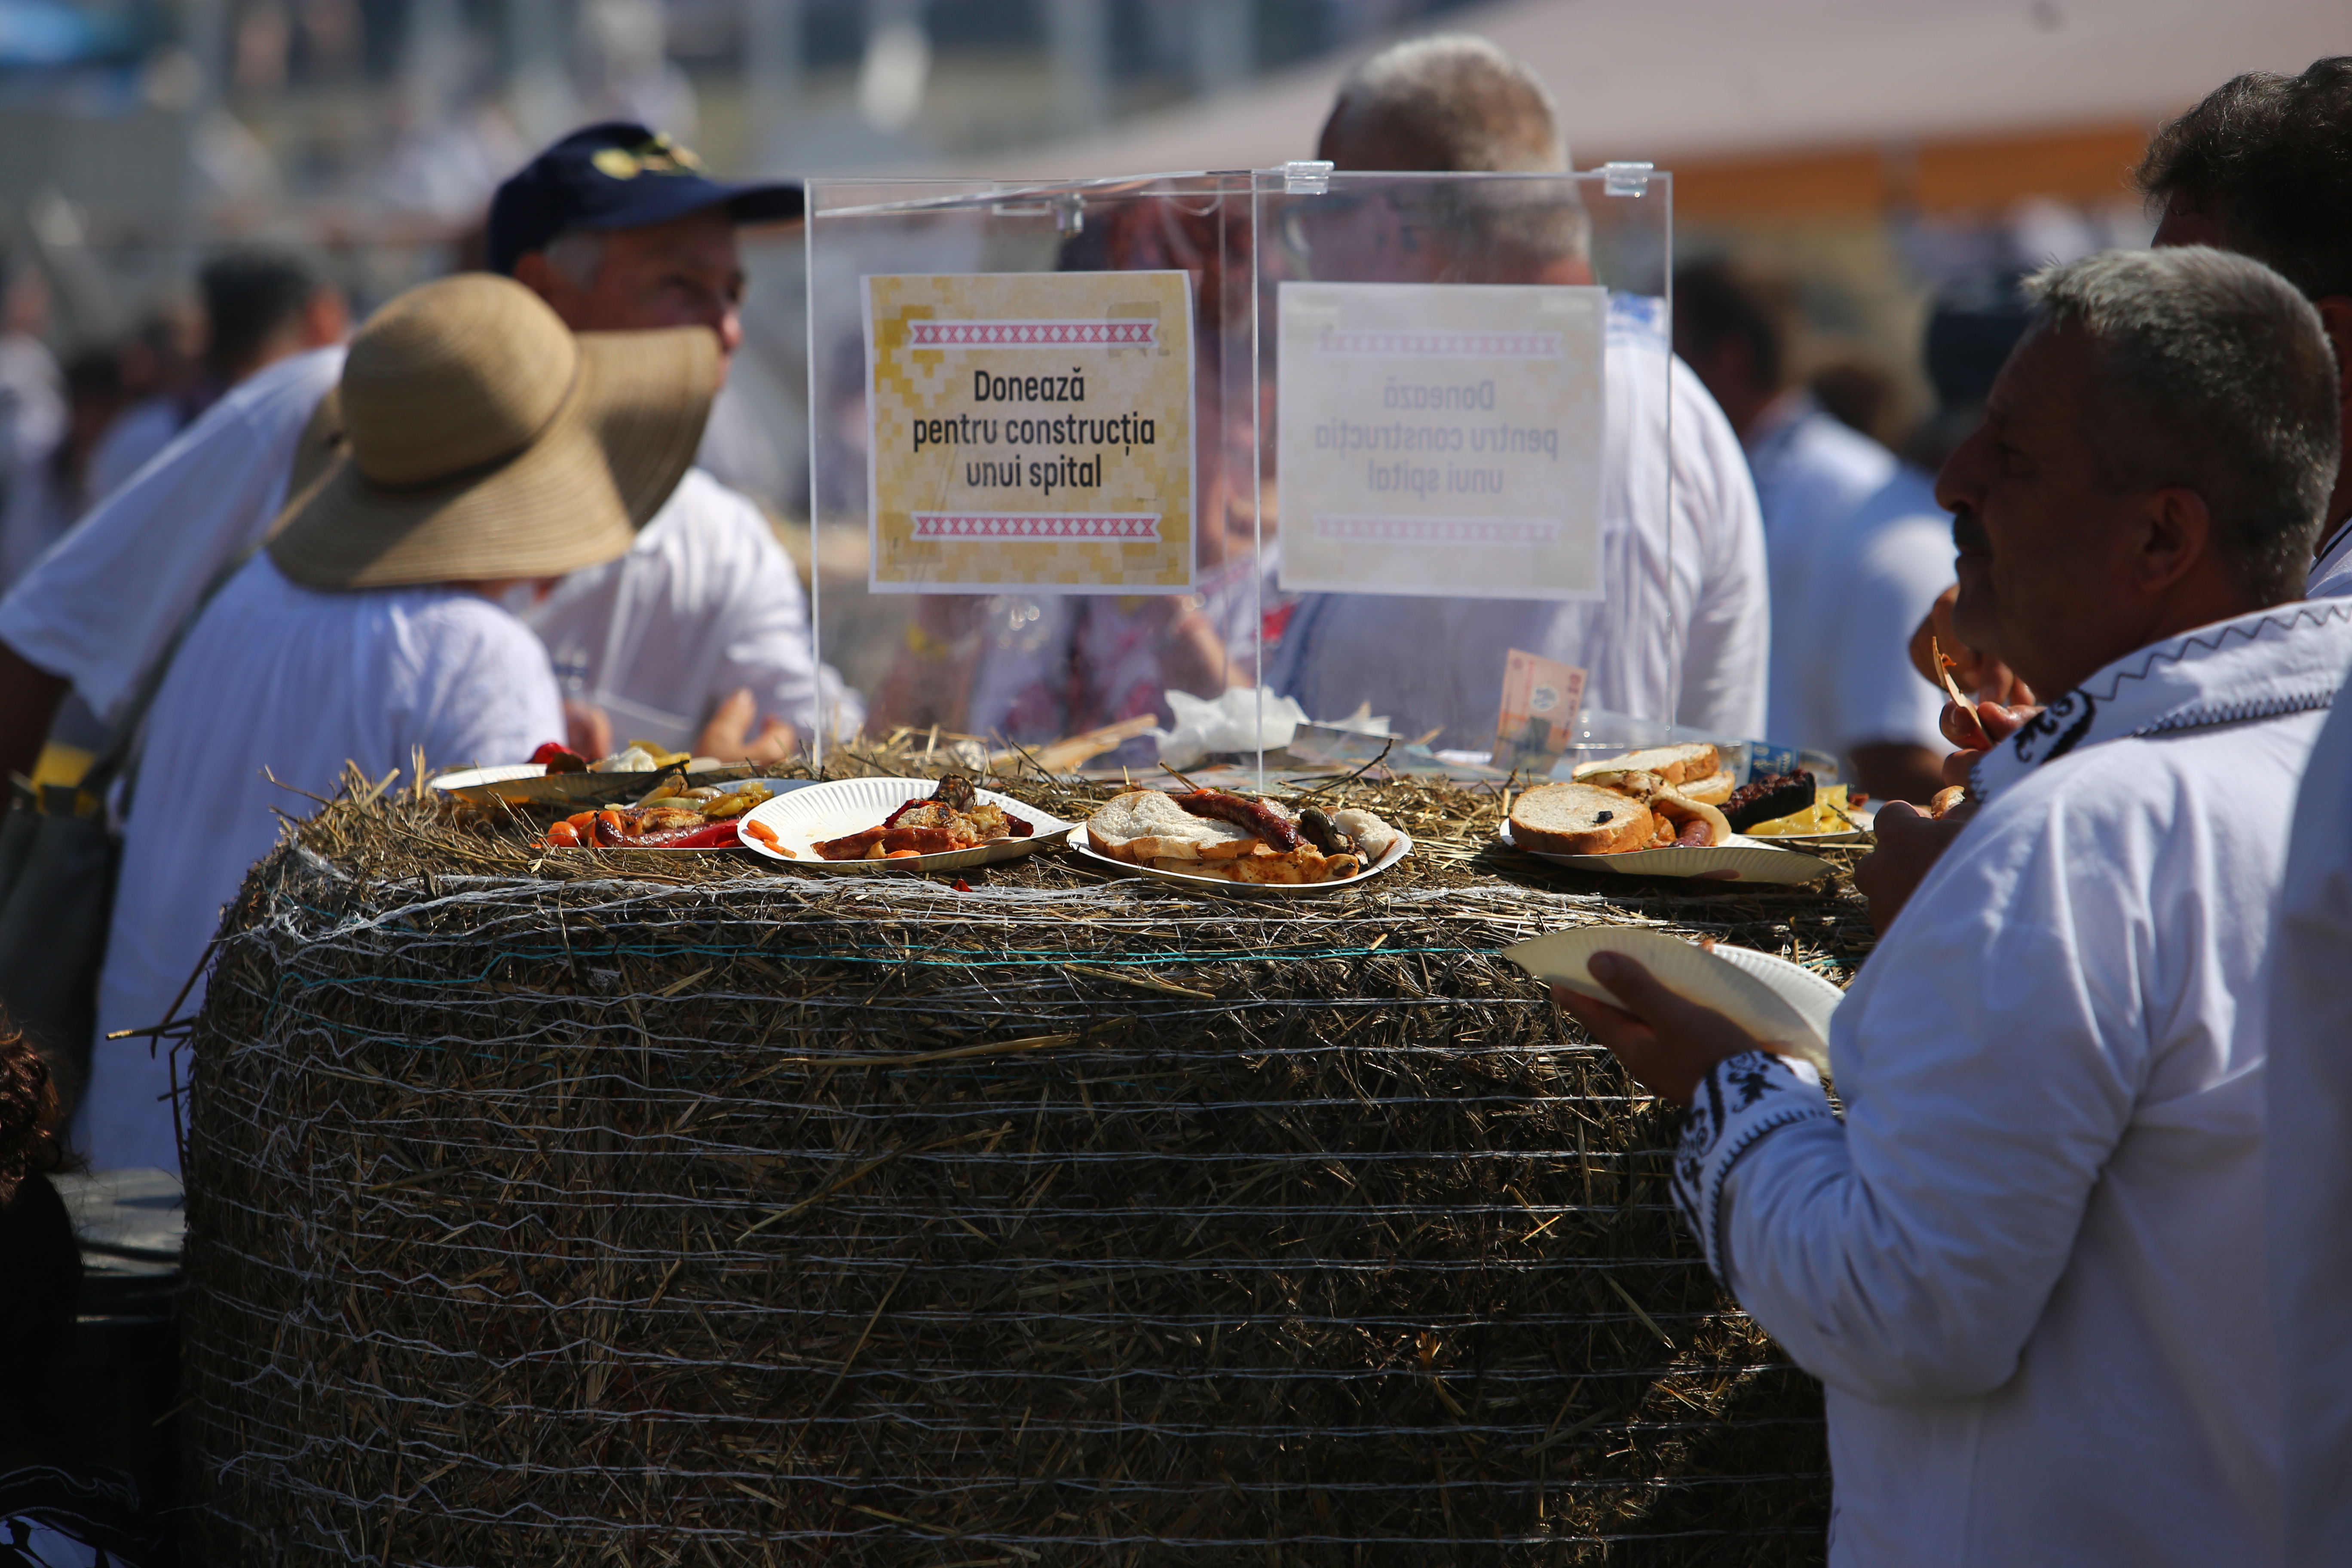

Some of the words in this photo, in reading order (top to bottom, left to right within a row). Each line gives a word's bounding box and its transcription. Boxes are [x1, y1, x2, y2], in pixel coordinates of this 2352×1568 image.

[974, 367, 1084, 401] Donează
[914, 413, 997, 453] pentru
[1006, 411, 1155, 457] construcția
[967, 454, 1021, 487] unui
[1029, 453, 1101, 496] spital
